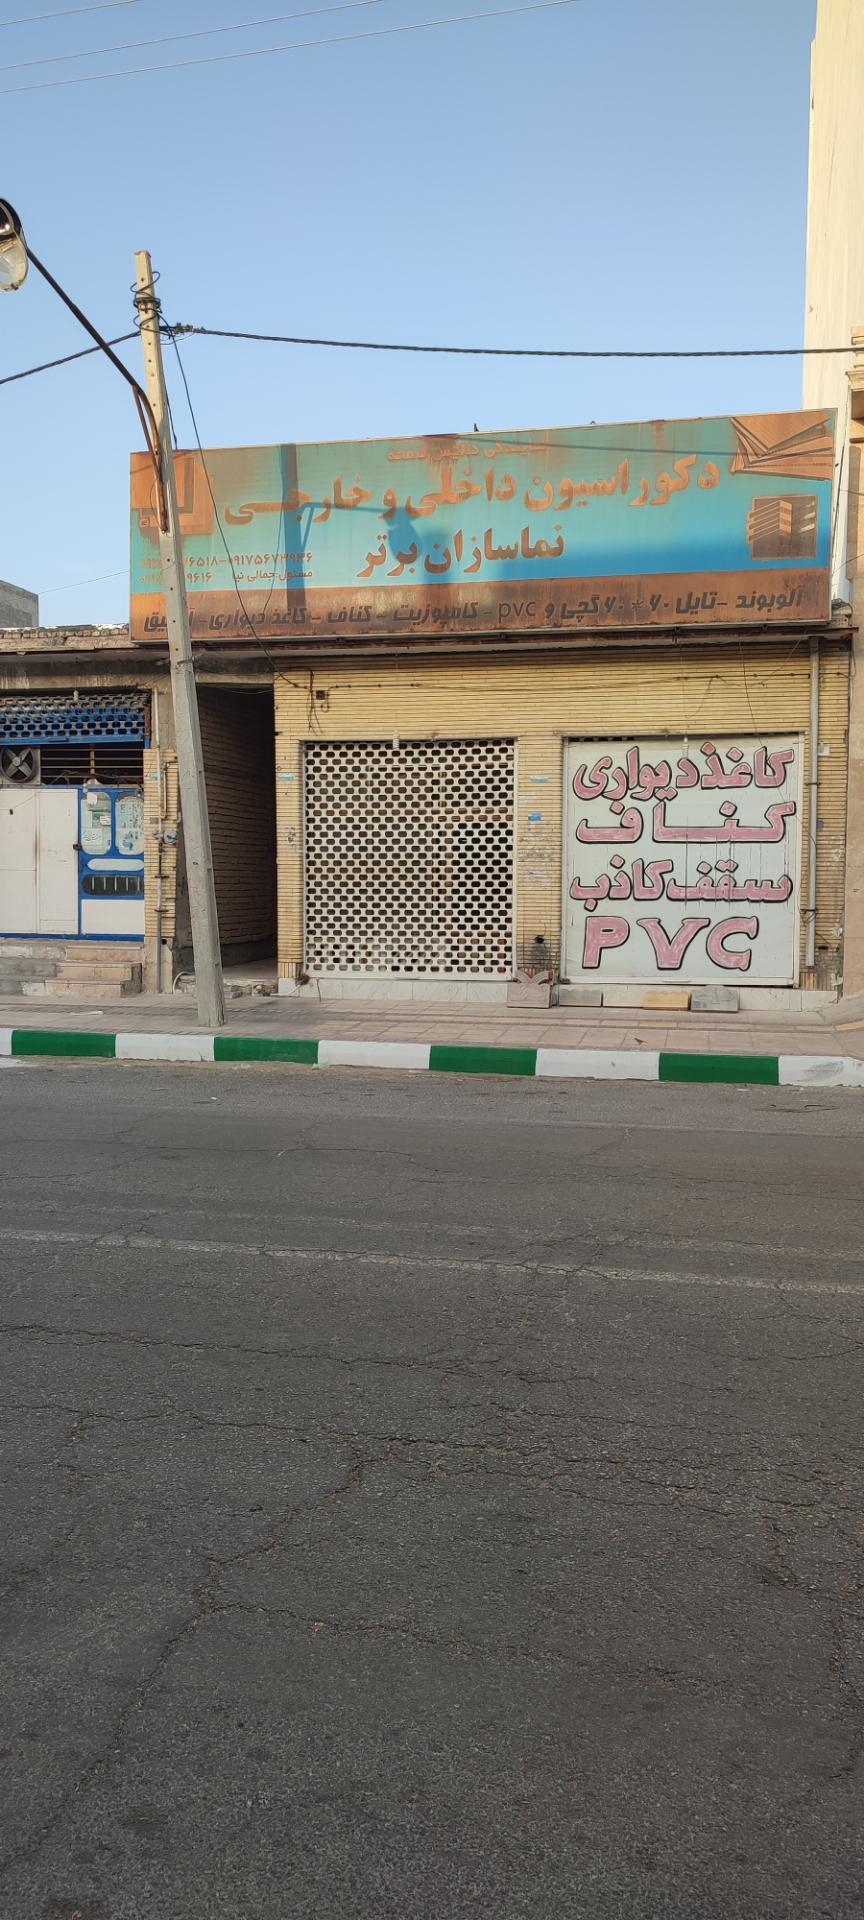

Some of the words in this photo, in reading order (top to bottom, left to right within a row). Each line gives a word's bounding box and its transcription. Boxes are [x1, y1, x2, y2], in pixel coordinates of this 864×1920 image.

[225, 473, 373, 525] خارجی
[378, 487, 398, 520] و
[405, 461, 517, 518] داخلی
[524, 454, 721, 511] دکوراسیون
[357, 534, 418, 578] برتر
[425, 524, 566, 575] نماسازان
[208, 609, 267, 631] دیواری
[271, 607, 308, 625] کاغذ
[328, 605, 372, 624] کناف
[393, 602, 479, 627] کامپوزیت
[497, 601, 537, 624] pvc
[544, 600, 556, 620] و
[561, 594, 601, 623] گچی
[735, 587, 806, 613] آلوبوند
[572, 745, 699, 802] دیواری
[700, 741, 796, 790] کاغذ
[575, 800, 797, 845] کناف
[569, 854, 674, 912] کاذب
[666, 858, 794, 903] سقف
[581, 915, 760, 972] PVC
